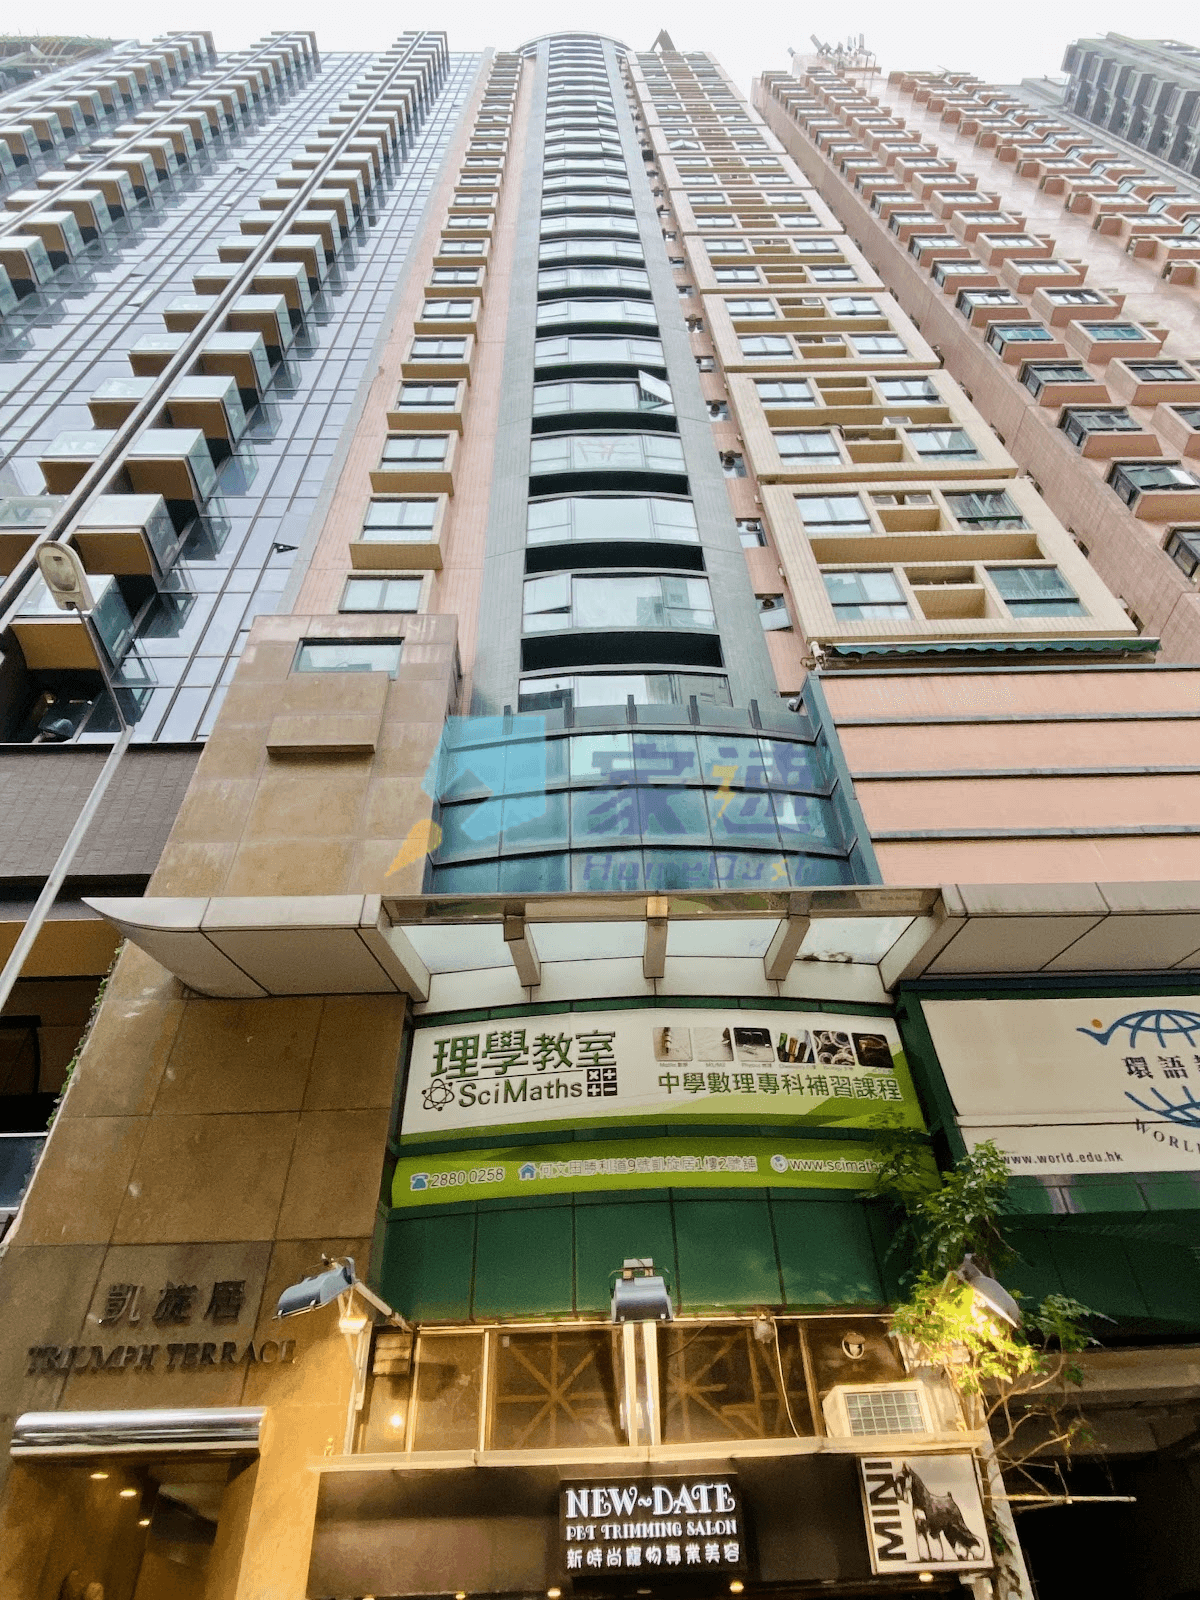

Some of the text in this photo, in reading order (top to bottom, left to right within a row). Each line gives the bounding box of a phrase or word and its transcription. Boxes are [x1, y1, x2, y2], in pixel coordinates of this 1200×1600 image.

[430, 1028, 617, 1080] 理學教室
[458, 1076, 583, 1108] SciMaths
[658, 1071, 902, 1100] 中學數理專科補習課程
[431, 1168, 504, 1187] 2880 0258
[27, 1339, 297, 1376] TRIUMPH TERRACE
[864, 1462, 907, 1561] MINI
[565, 1519, 737, 1541] PET TRIMMING SALON
[566, 1542, 740, 1569] 新時尚寵物專業美容
